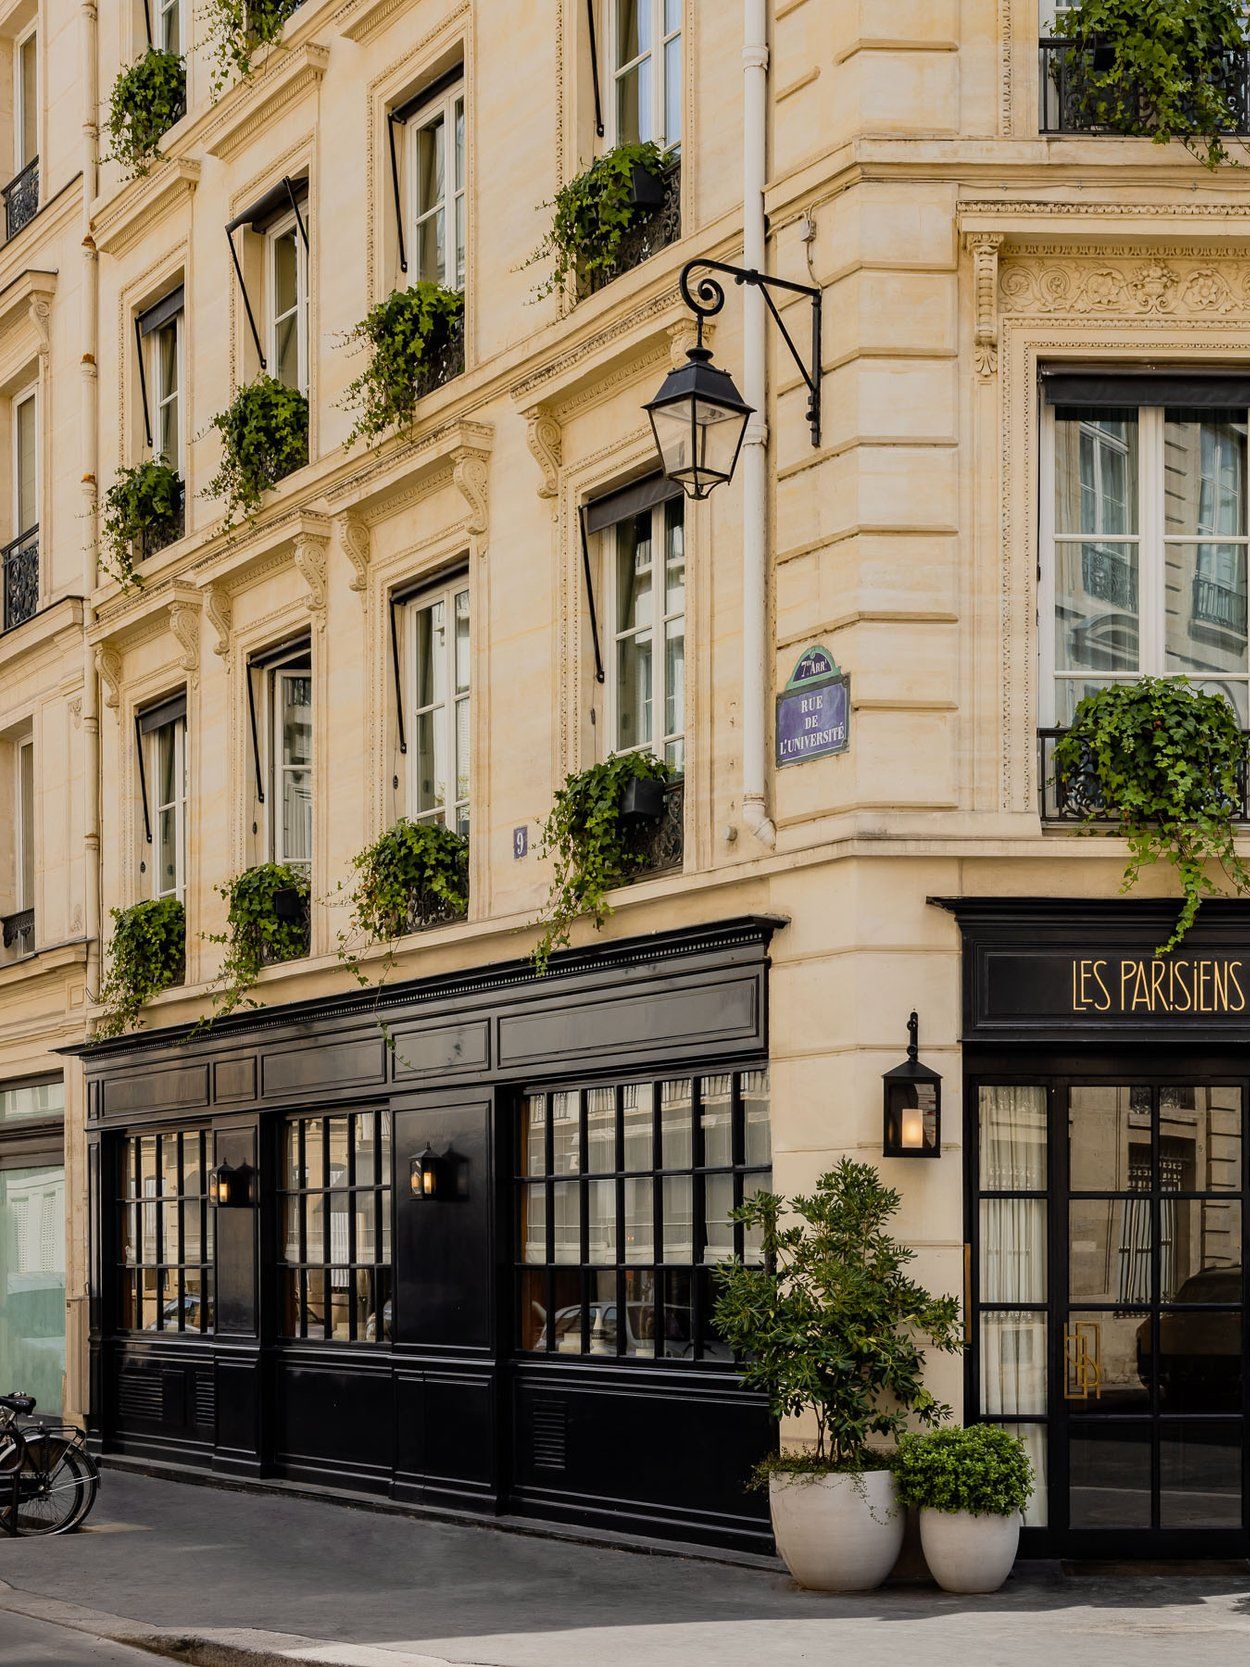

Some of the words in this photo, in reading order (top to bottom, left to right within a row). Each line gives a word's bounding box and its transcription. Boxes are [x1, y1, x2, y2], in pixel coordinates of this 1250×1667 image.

[801, 695, 823, 713] RUE
[805, 715, 819, 729] DE
[780, 722, 845, 755] L'UNIVERSITÉ
[517, 832, 524, 855] 9
[1072, 960, 1111, 1011] LES
[1120, 960, 1246, 1011] PARISIENS
